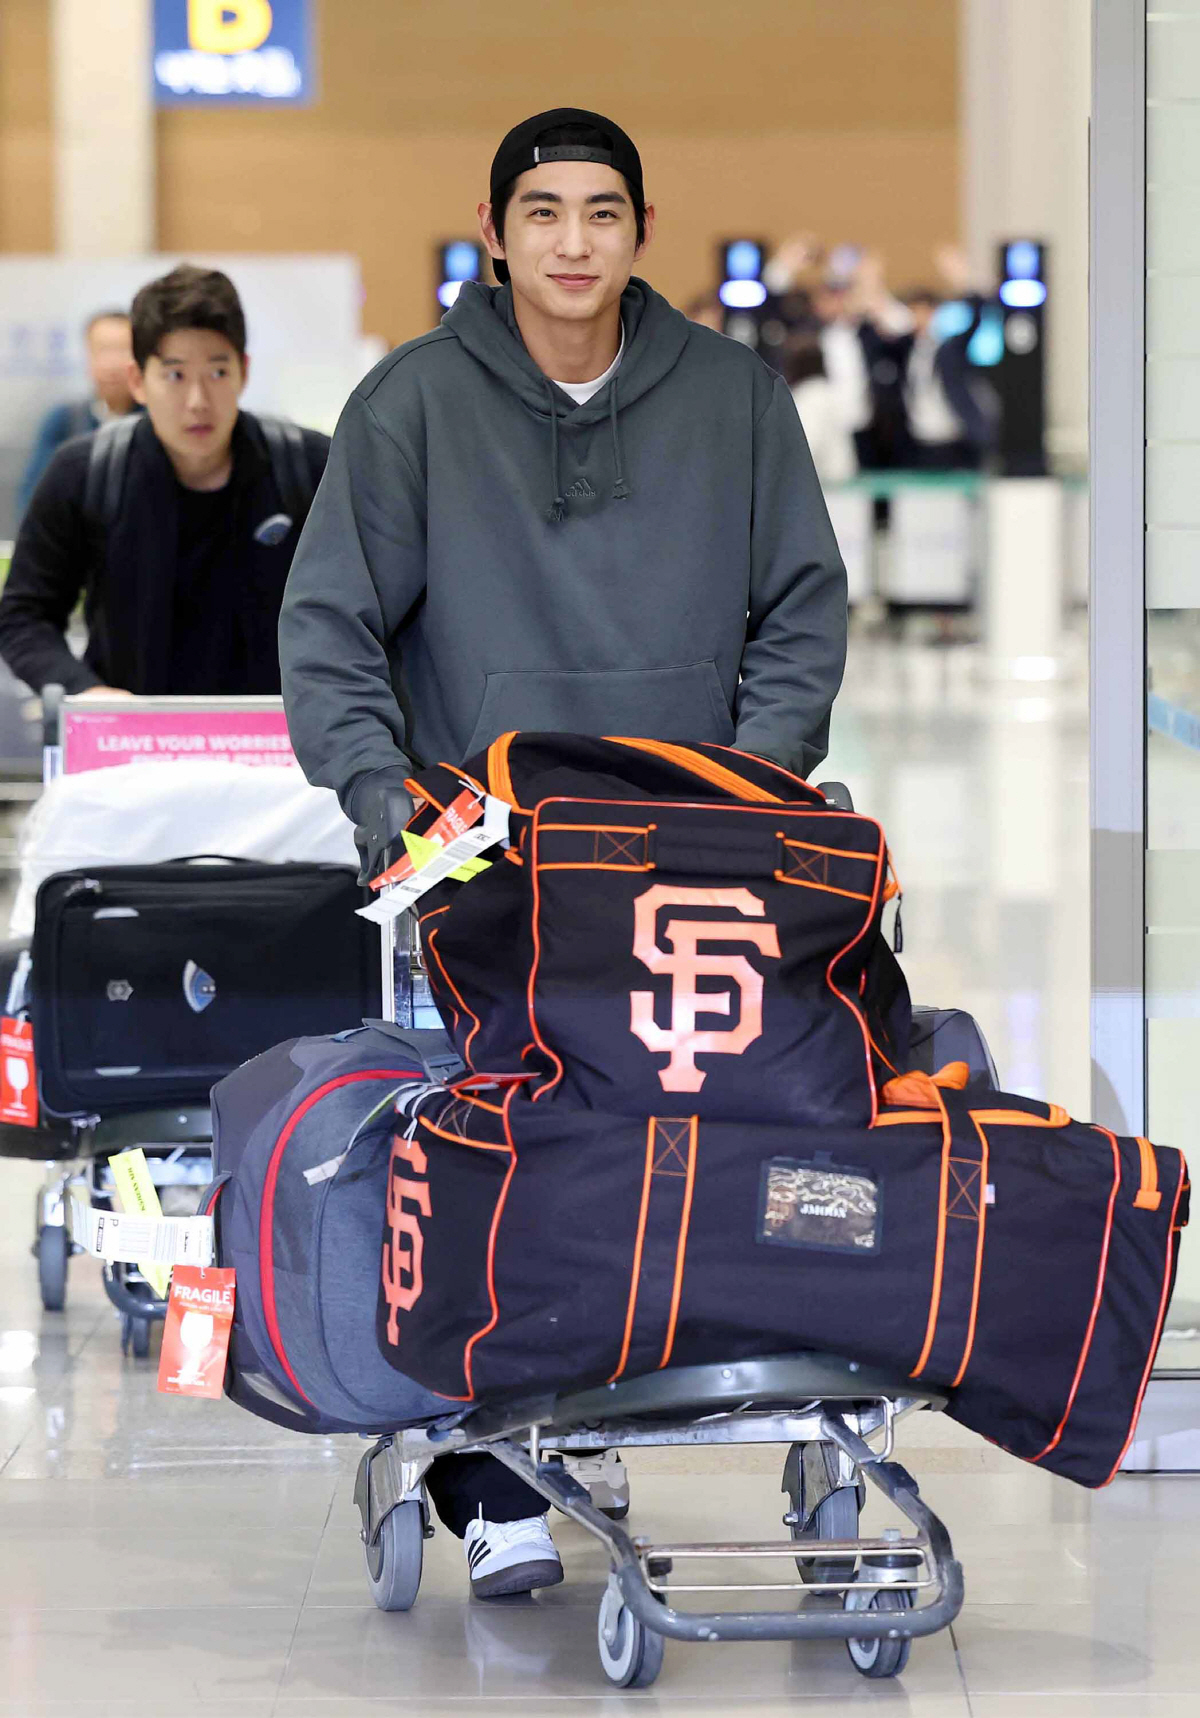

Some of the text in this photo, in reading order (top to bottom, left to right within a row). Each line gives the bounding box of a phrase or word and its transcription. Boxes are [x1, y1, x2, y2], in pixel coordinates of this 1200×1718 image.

[97, 735, 153, 751] LEAVE
[156, 735, 205, 751] YOUR
[173, 1285, 231, 1305] FRAGILE
